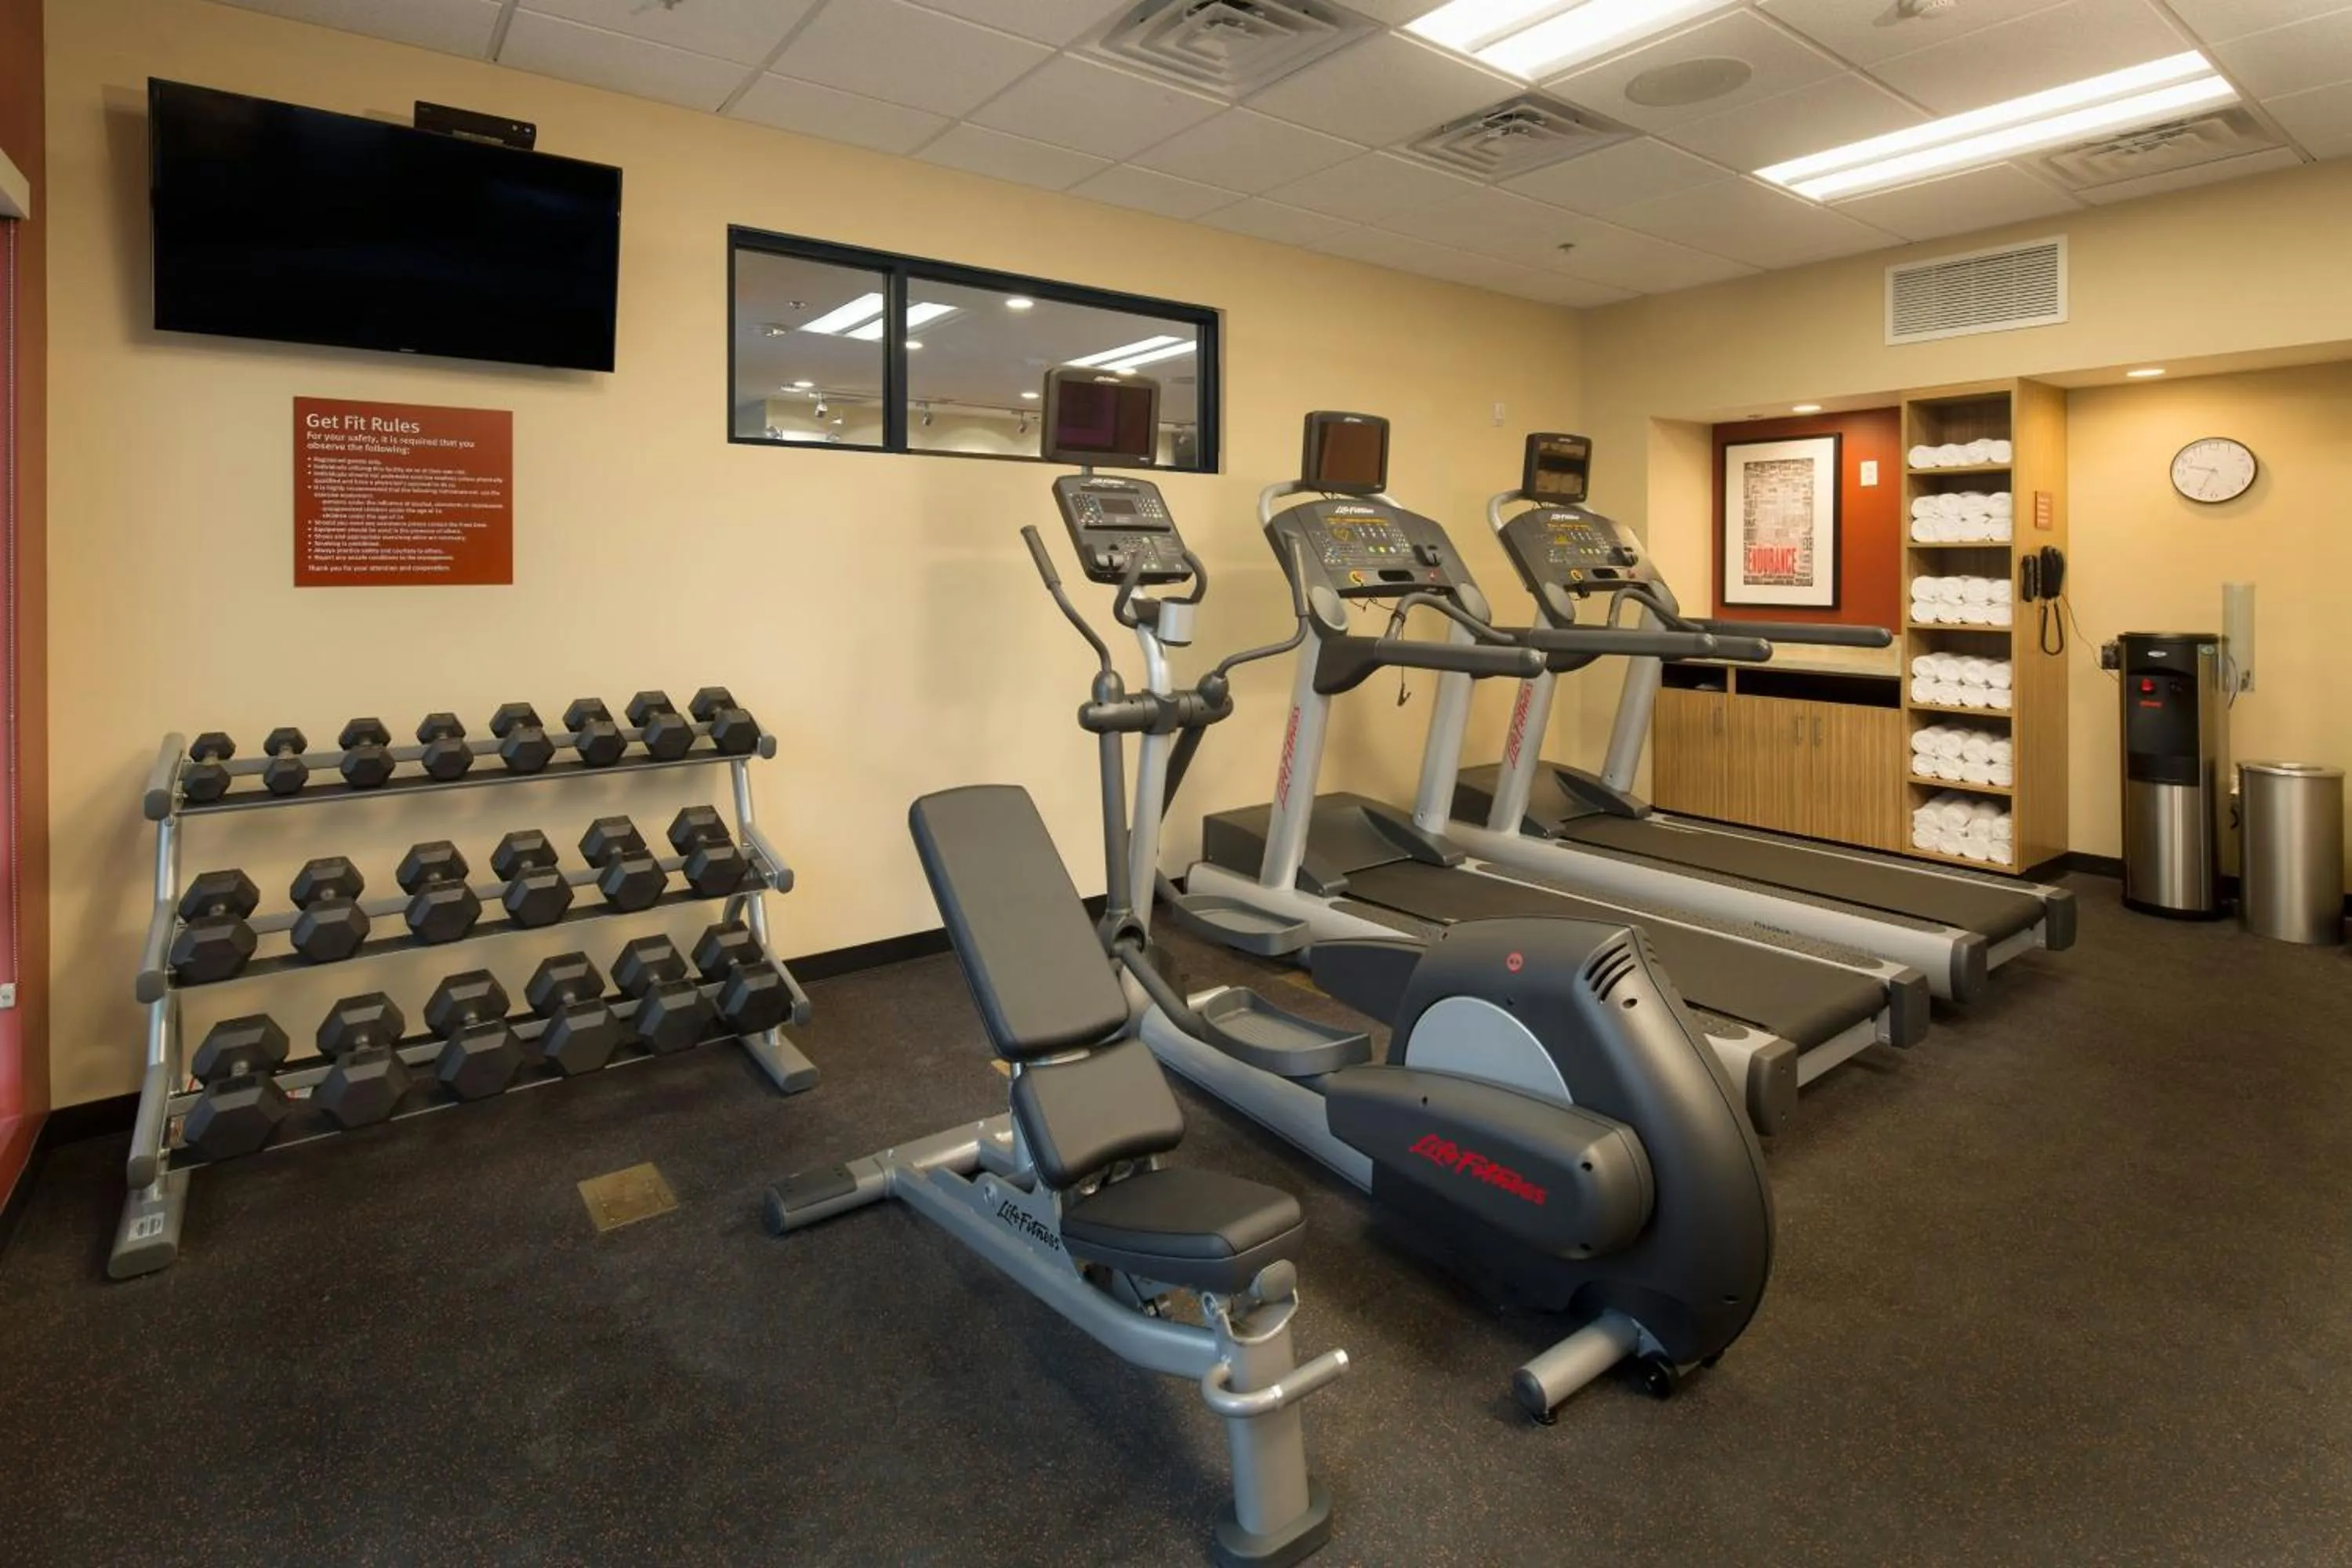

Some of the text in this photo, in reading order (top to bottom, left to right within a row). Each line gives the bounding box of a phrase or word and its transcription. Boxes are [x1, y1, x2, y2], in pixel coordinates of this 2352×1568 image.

[307, 413, 420, 434] Get Fit Rules
[307, 430, 322, 440] For
[324, 433, 345, 441] your
[347, 434, 379, 444] safety,
[459, 441, 475, 449] you
[1748, 547, 1797, 575] ENDURANCE
